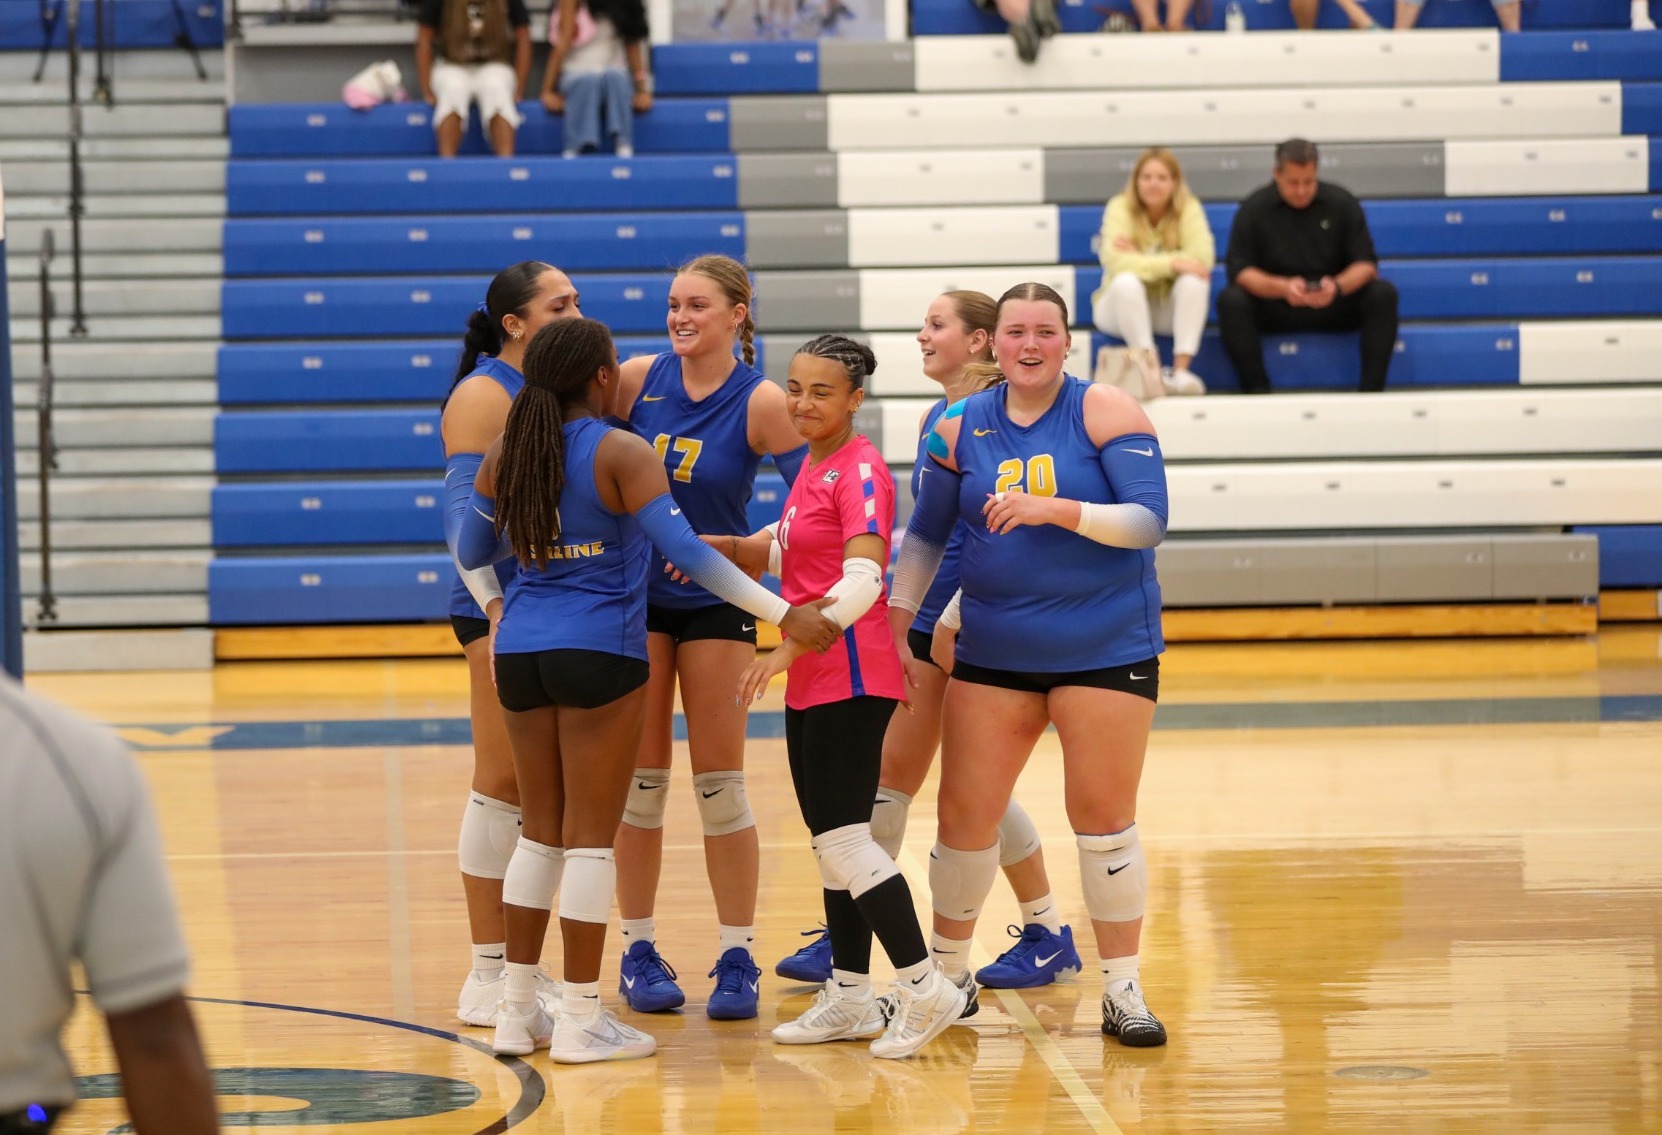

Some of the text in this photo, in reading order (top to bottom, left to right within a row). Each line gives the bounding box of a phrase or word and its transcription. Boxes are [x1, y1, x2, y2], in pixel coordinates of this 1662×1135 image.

[653, 433, 703, 483] 17
[995, 453, 1058, 498] 20
[780, 505, 797, 551] 6
